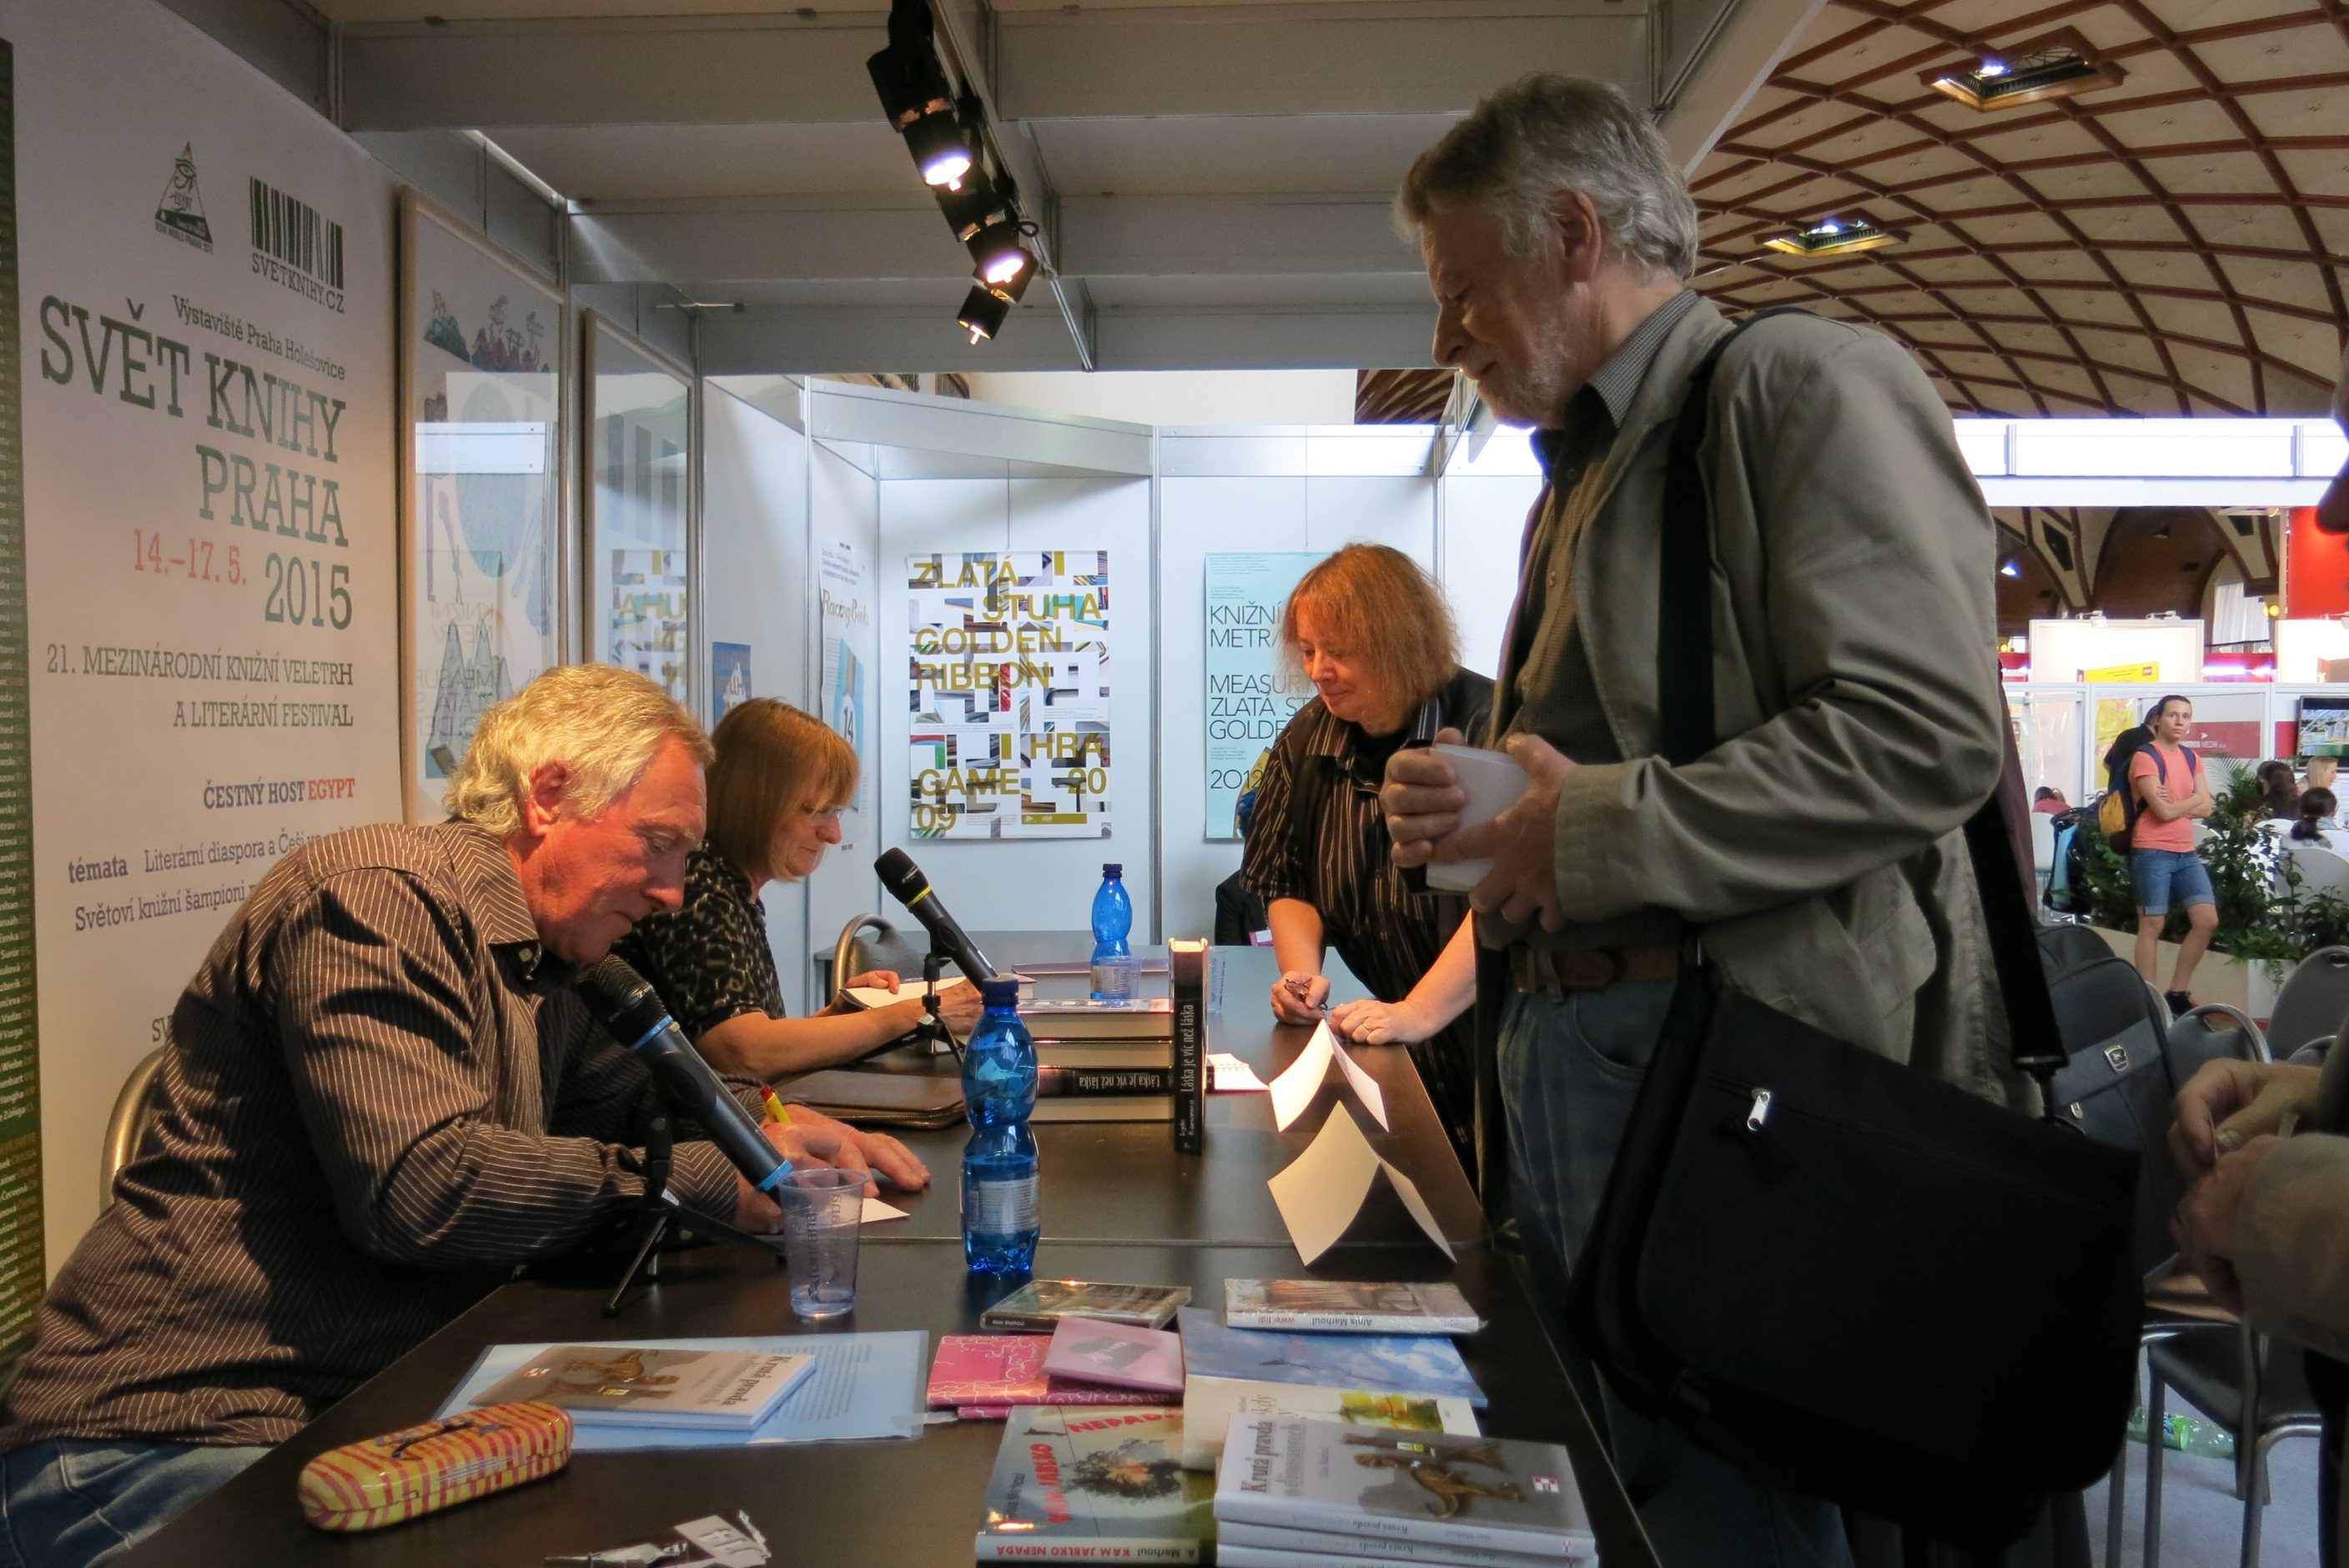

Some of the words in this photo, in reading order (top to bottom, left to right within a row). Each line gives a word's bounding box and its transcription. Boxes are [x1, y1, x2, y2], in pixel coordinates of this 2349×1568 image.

[252, 252, 345, 314] SVETKNIHY.CZ
[172, 294, 244, 341] Výstaviště
[247, 323, 283, 356] Praha
[285, 340, 345, 381] Holešovice
[40, 294, 191, 419] SVĚT
[204, 352, 347, 463] KNIHY
[195, 444, 349, 548] PRAHA
[913, 556, 1019, 589] ZLATÁ
[264, 552, 353, 631] 2015
[982, 593, 1102, 622] STUHA
[1210, 601, 1282, 625] KNIŽNÍ
[915, 626, 1062, 656] GOLDEN
[47, 643, 76, 675] 21.
[83, 641, 222, 680] MEZINÁRODNÍ
[226, 650, 279, 683] KNIŽNÍ
[282, 659, 353, 686] VELETRH
[916, 661, 1050, 691] RIBBON
[174, 701, 187, 727] A
[191, 695, 279, 727] LITERÁRNÍ
[281, 702, 353, 727] FESTIVAL
[1210, 694, 1276, 716] ZLATÁ
[1029, 731, 1104, 760] HRA
[203, 777, 265, 810] ČESTNÝ
[268, 781, 305, 805] HOST
[308, 777, 356, 802] EGYPT
[917, 767, 1020, 796] GAME
[1067, 766, 1107, 796] 20
[1210, 769, 1262, 790] 2012
[916, 803, 958, 831] 09
[68, 854, 129, 884] témata
[144, 841, 204, 873] Literární
[208, 836, 265, 867] diaspora
[269, 840, 276, 856] a
[75, 897, 135, 932] Světoví
[138, 890, 182, 920] knižní
[185, 880, 246, 912] šampioni
[1181, 1055, 1196, 1068] je
[1248, 1421, 1279, 1457] pravda
[1241, 1456, 1268, 1493] Krutá
[1051, 1546, 1096, 1556] JABLKO
[1099, 1546, 1131, 1557] KAM
